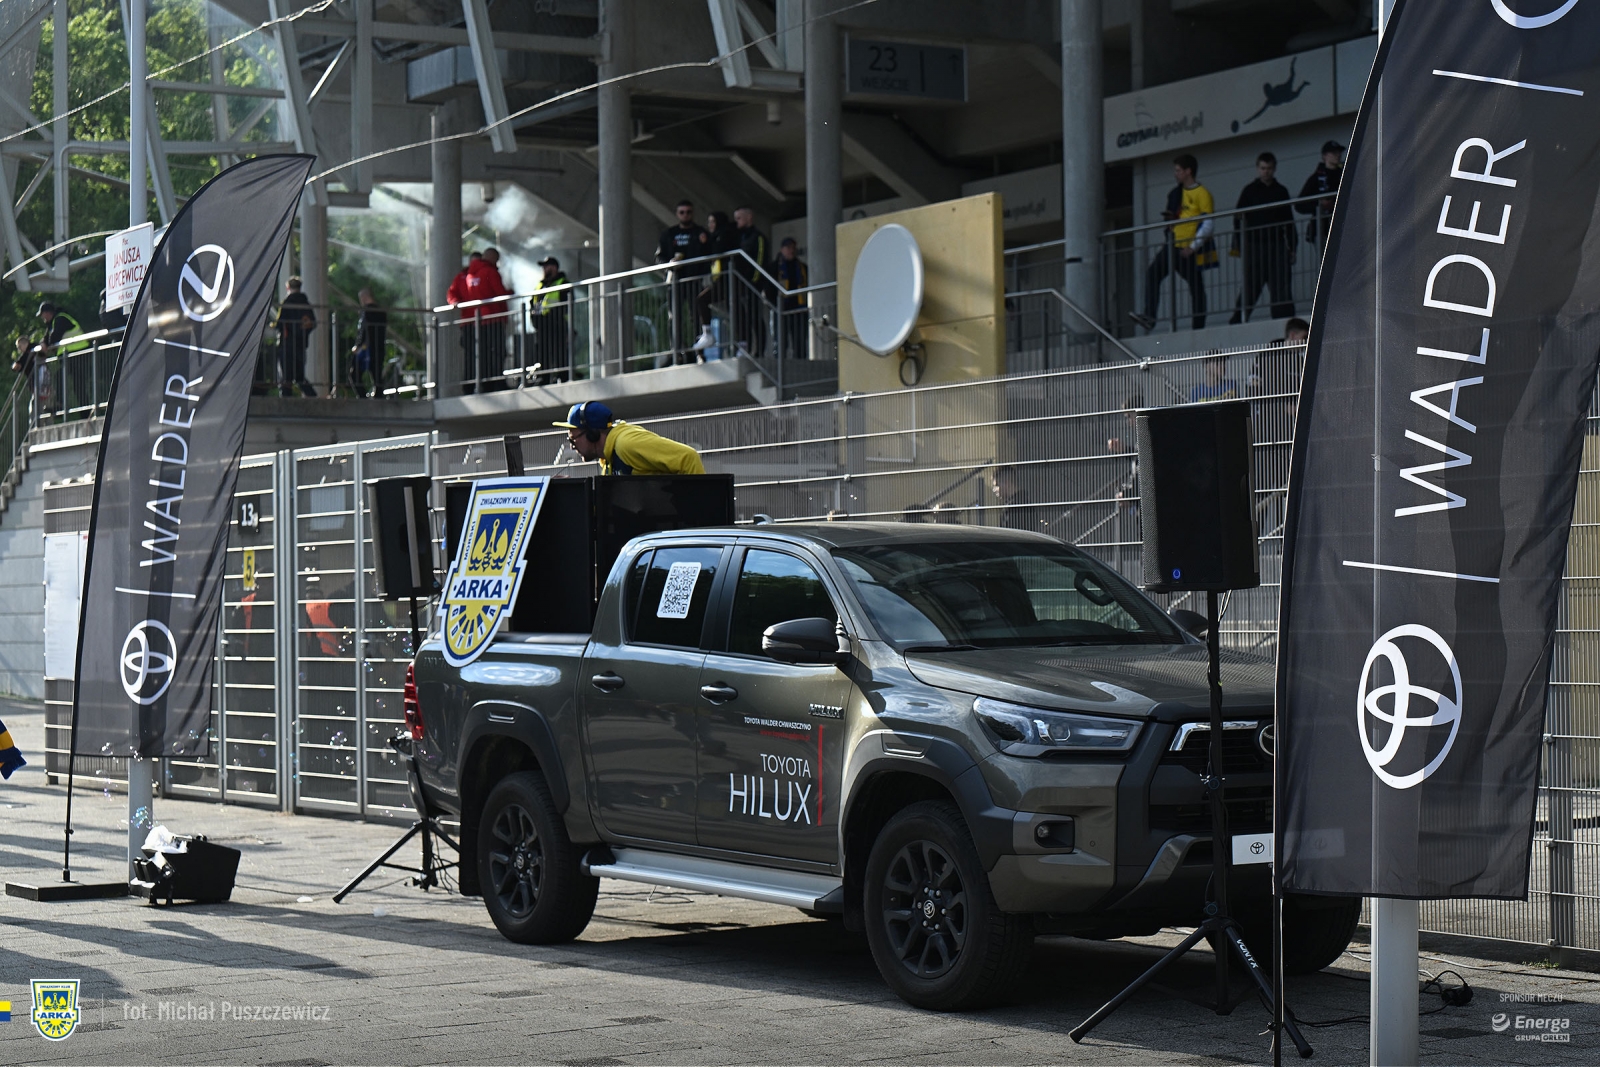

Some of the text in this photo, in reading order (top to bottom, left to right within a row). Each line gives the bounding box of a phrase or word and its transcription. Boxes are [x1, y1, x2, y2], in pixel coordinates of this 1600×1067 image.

[868, 46, 898, 72] 23
[113, 246, 141, 269] JANUSZA
[1394, 137, 1527, 518] WALDER
[140, 374, 203, 568] WALDER
[480, 496, 528, 507] ZWIĄZKOWY KLUB
[507, 509, 529, 567] SPORTOWY
[246, 556, 252, 582] 5
[454, 579, 503, 599] ARKA
[744, 716, 760, 726] TOYOTA
[760, 719, 778, 728] WALDER
[760, 754, 811, 778] TOYOTA
[729, 772, 812, 825] HILUX
[1236, 939, 1259, 969] VONYX
